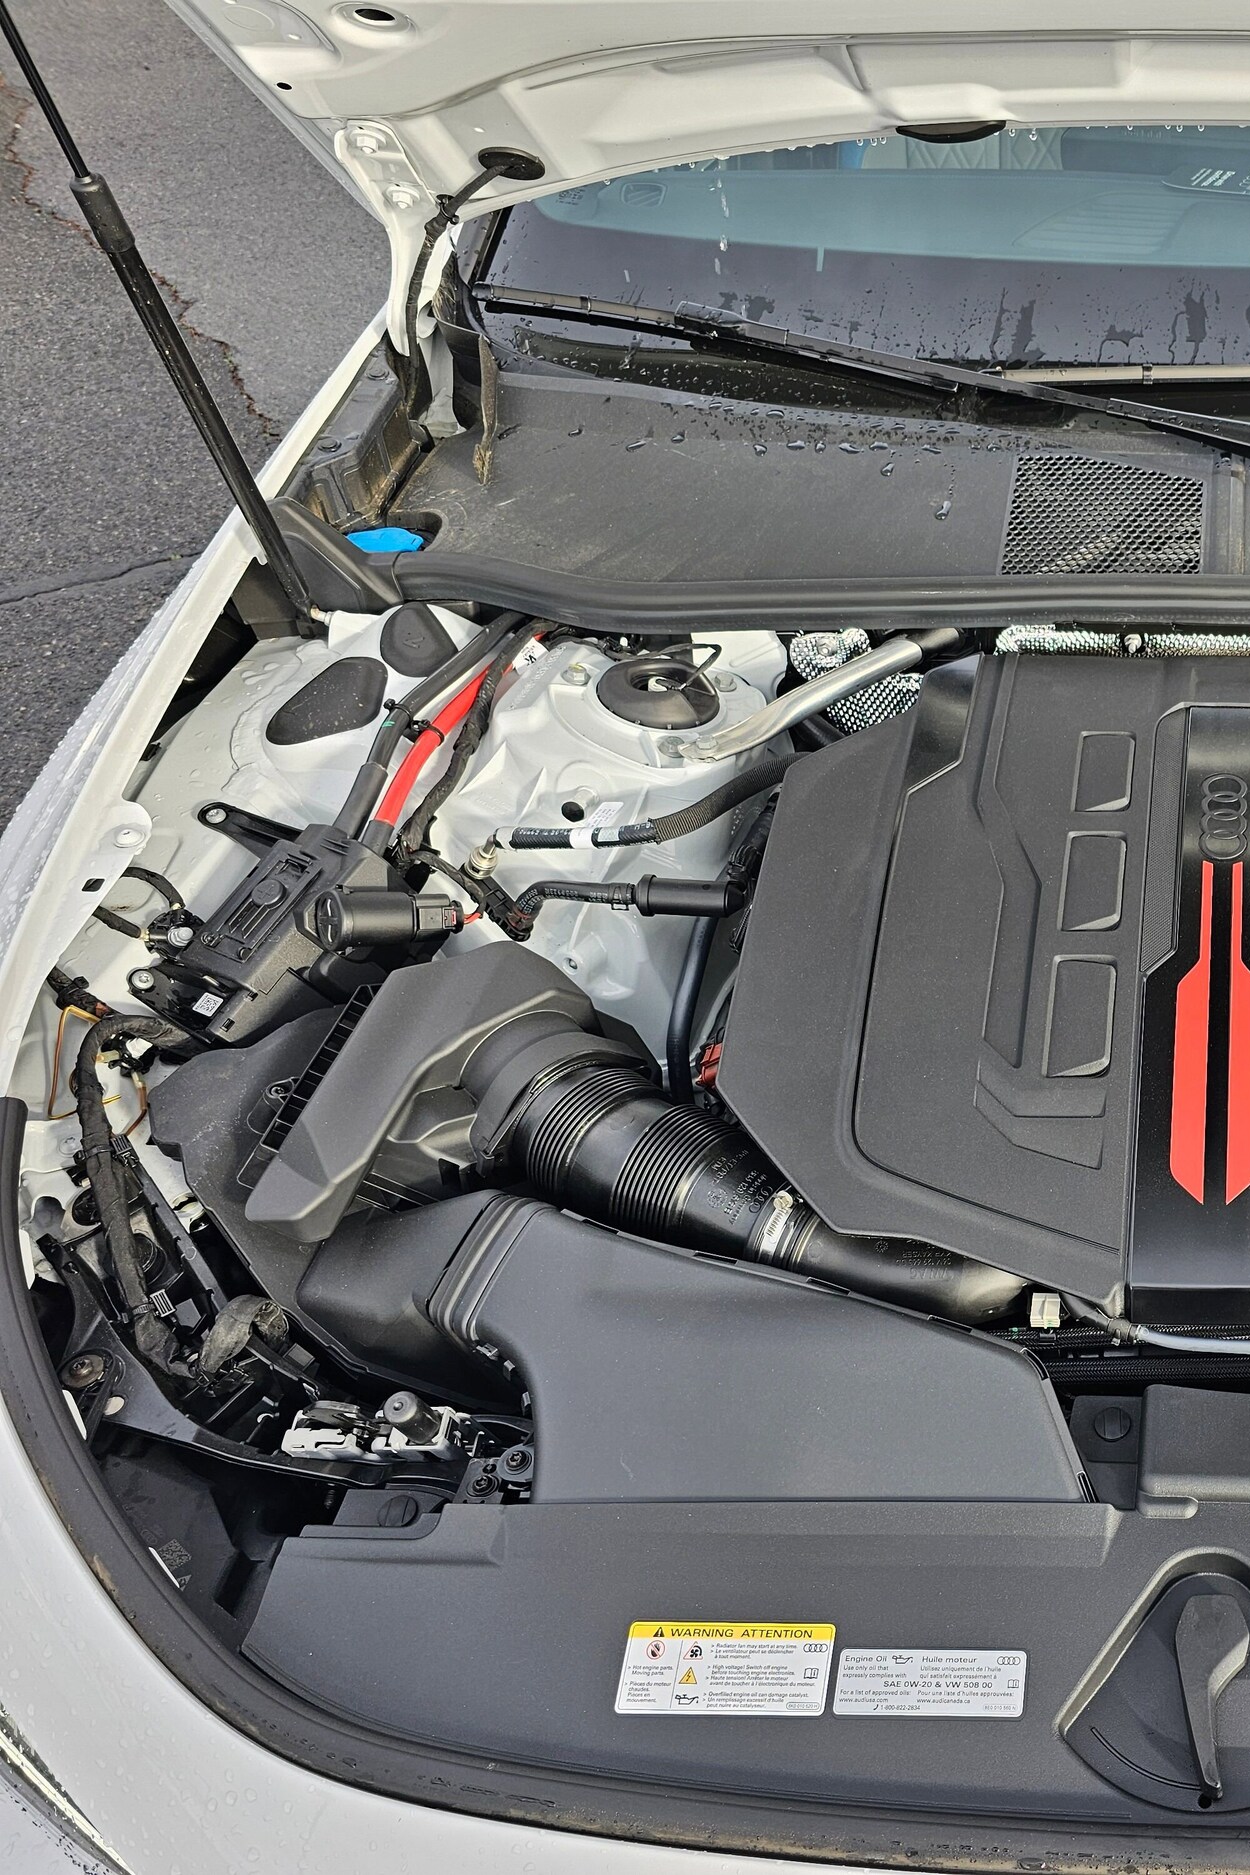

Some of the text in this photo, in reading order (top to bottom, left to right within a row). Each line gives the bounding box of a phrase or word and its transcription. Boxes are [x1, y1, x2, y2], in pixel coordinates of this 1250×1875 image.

[671, 1628, 813, 1639] WARNING ATTENTION
[845, 1655, 874, 1663] Engine
[883, 1680, 902, 1688] SAE
[981, 1681, 993, 1689] 00
